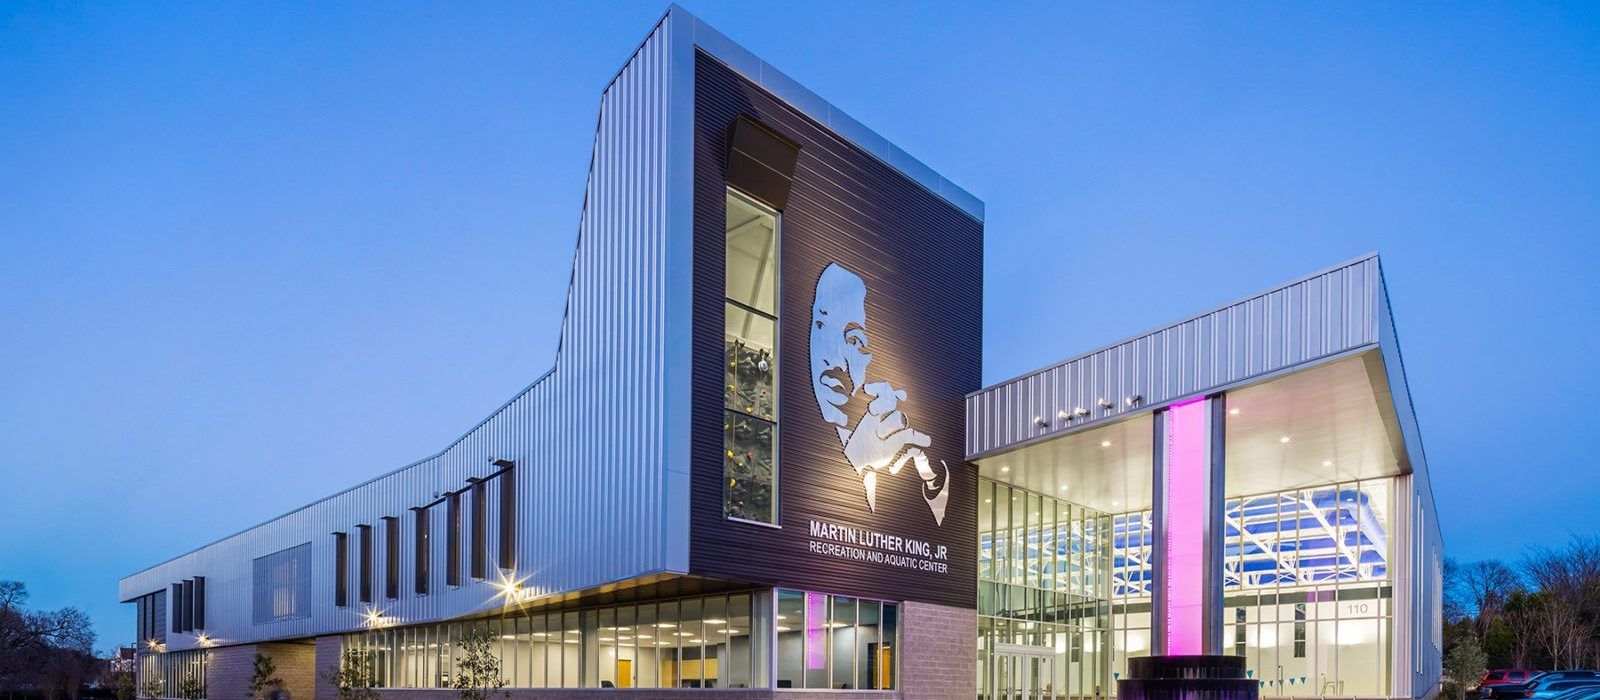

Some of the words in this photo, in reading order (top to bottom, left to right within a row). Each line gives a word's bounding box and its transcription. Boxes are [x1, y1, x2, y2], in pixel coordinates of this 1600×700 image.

[810, 520, 856, 544] MARTIN
[859, 531, 902, 552] LUTHER
[905, 539, 932, 560] KING,
[935, 545, 947, 560] JR
[810, 541, 865, 561] RECREATION
[867, 551, 884, 564] AND
[885, 554, 918, 569] AQUATIC
[919, 560, 947, 574] CENTER
[1347, 603, 1368, 614] 110
